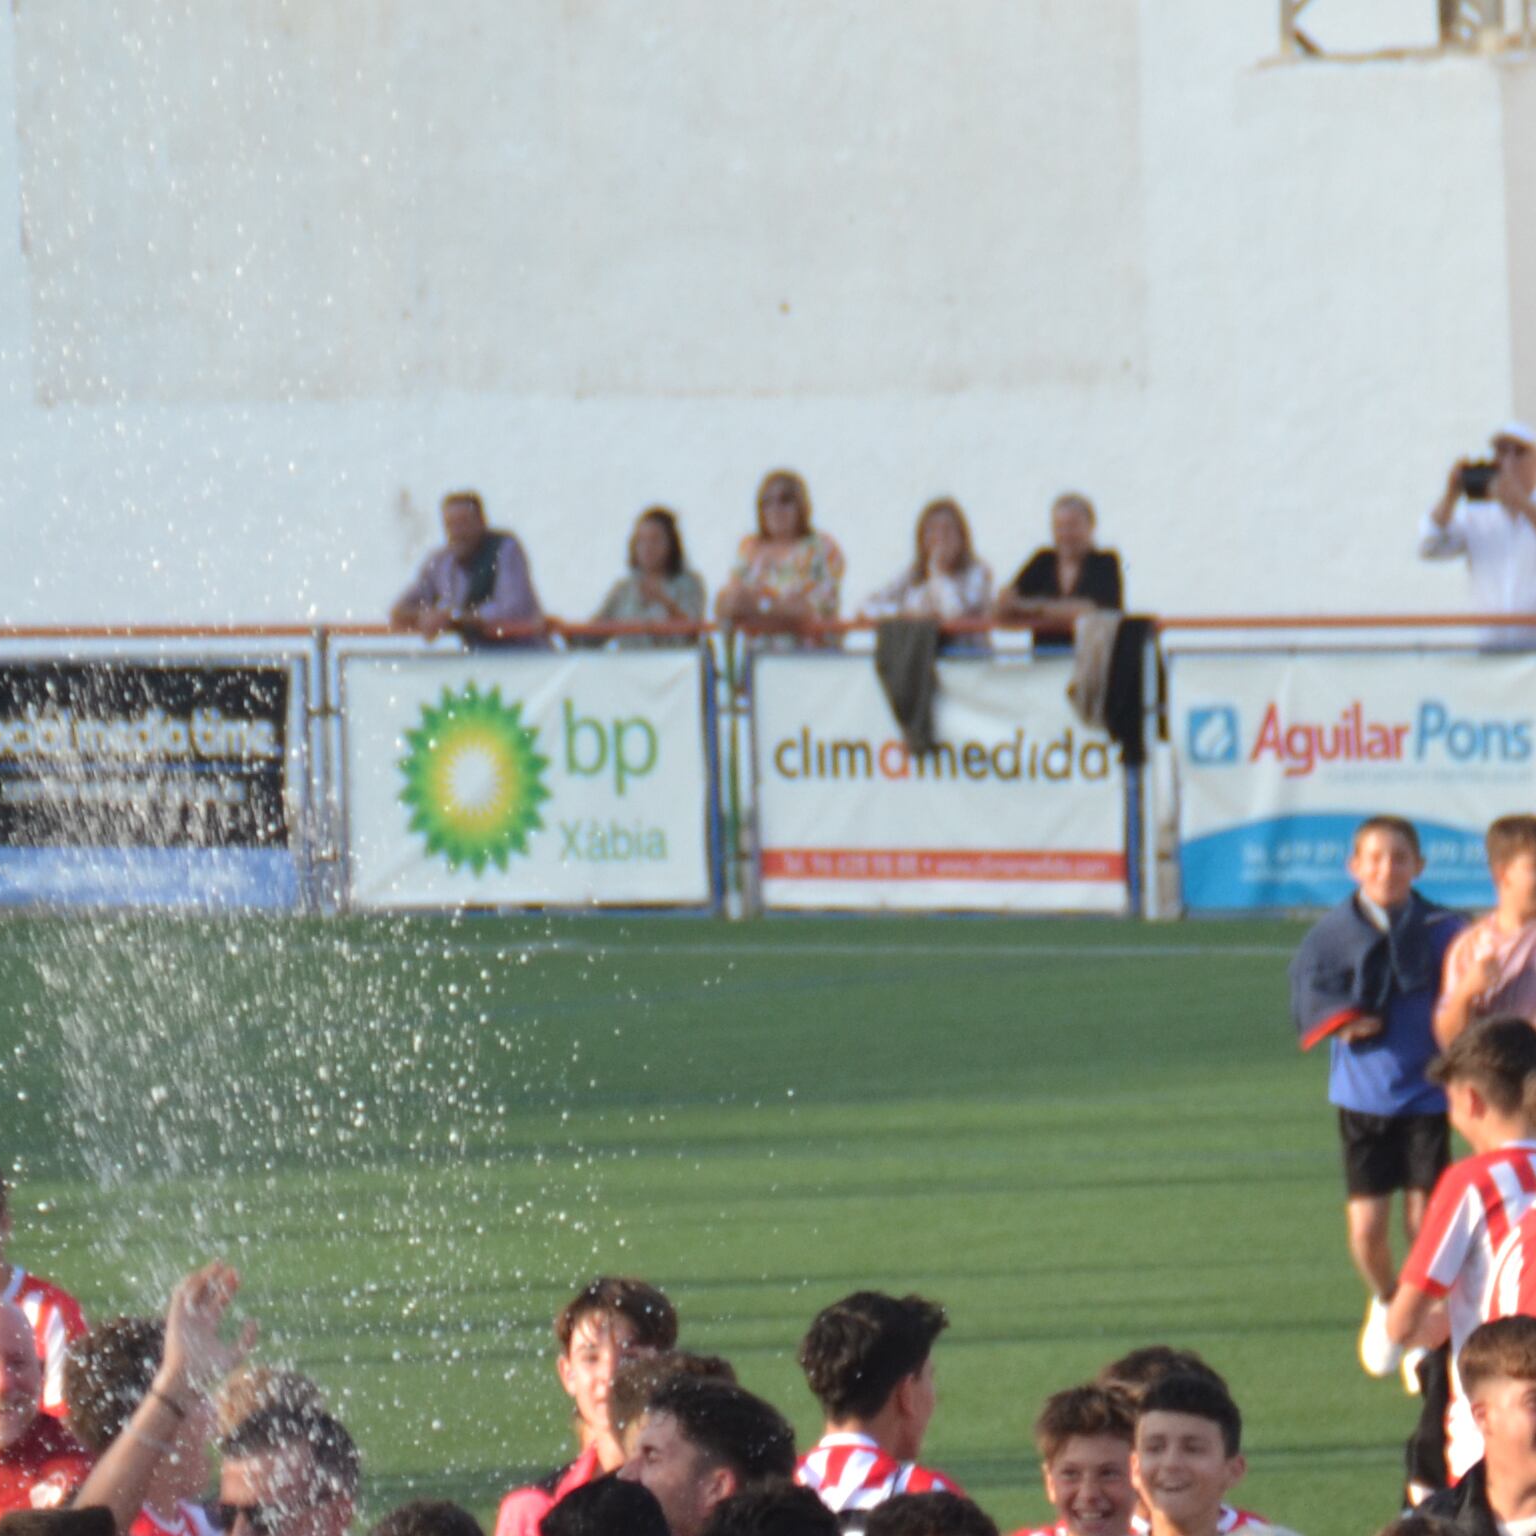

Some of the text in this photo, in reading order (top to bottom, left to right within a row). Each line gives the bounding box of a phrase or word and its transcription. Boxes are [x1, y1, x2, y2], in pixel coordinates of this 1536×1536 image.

[562, 696, 658, 797] bp
[773, 725, 1110, 781] climamedida
[1249, 701, 1532, 778] Aguilar Pons
